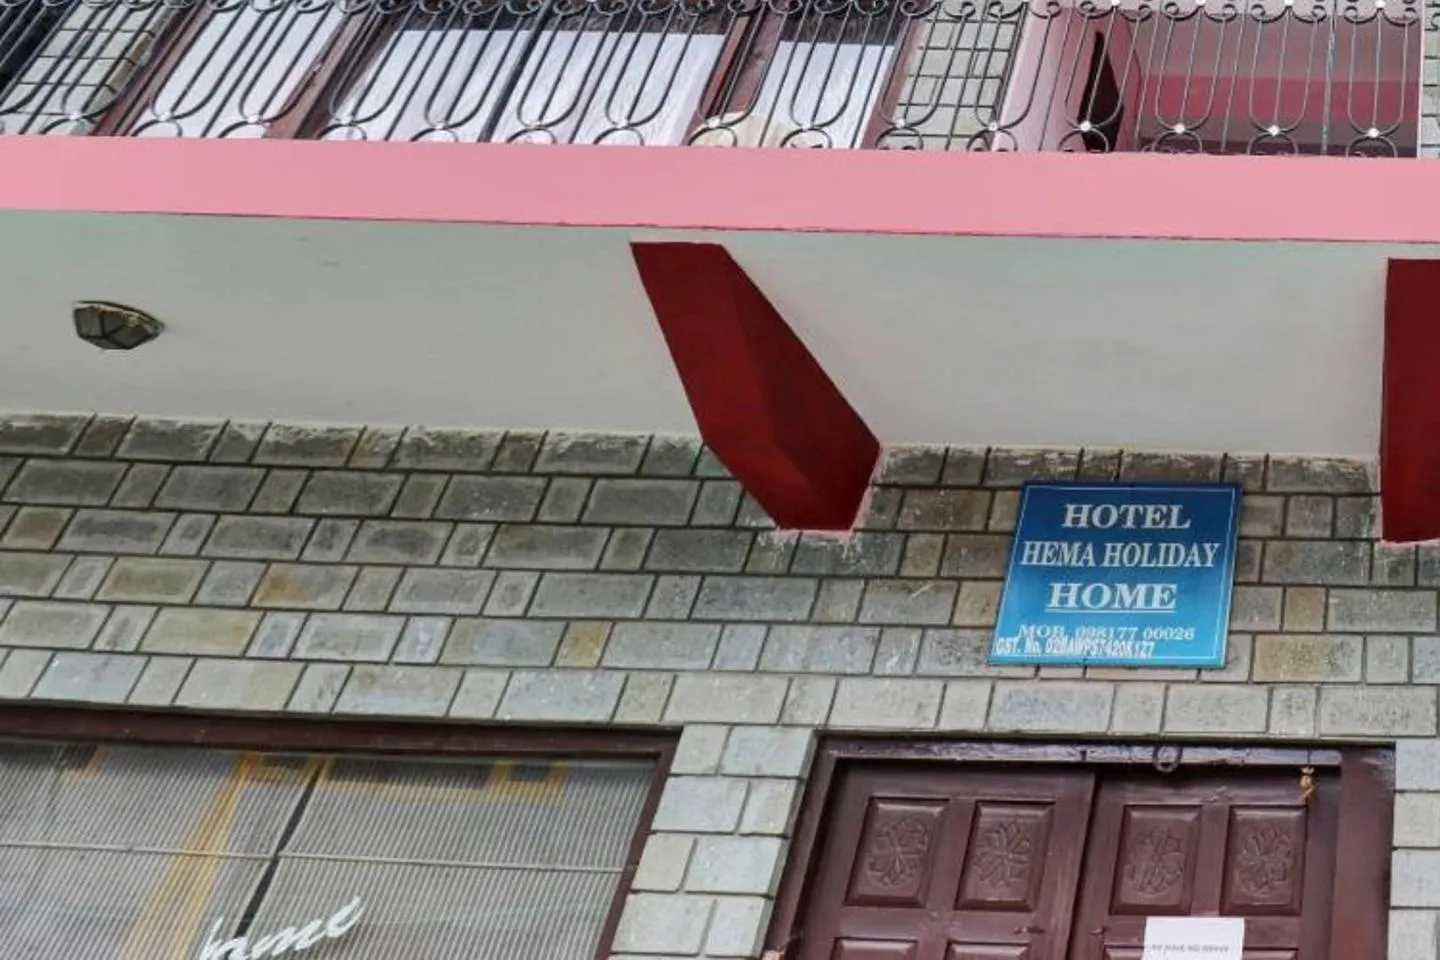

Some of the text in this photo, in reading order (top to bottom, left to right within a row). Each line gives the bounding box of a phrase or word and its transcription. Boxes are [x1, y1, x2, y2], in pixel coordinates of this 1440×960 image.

[1061, 503, 1192, 530] HOTEL
[1020, 540, 1222, 569] HEMA HOLIDAY
[1046, 582, 1178, 610] HOME
